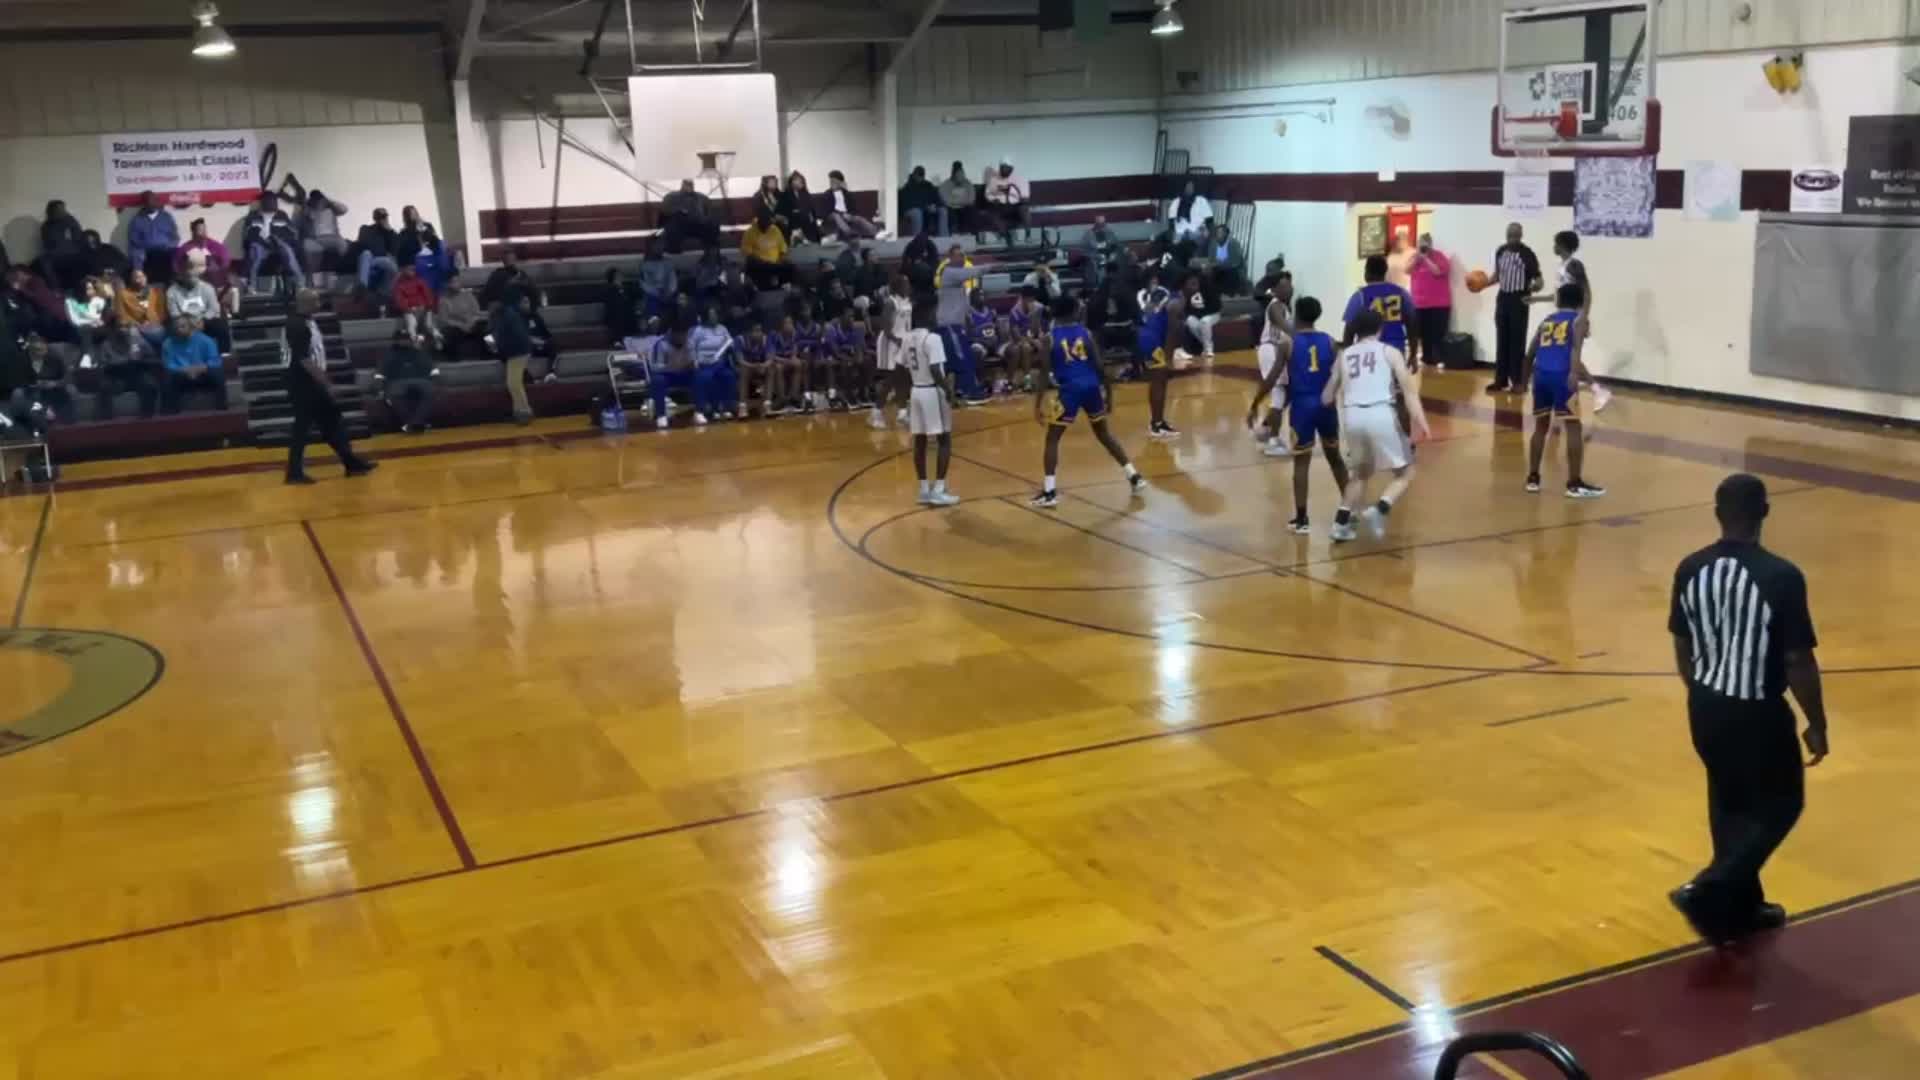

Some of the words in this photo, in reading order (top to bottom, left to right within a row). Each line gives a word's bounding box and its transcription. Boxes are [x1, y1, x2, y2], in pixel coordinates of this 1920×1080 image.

[172, 138, 245, 151] Hardwood
[112, 157, 198, 169] Tournament
[201, 154, 250, 166] Classic
[1540, 320, 1569, 347] 24
[1060, 336, 1089, 363] 14
[1307, 345, 1319, 373] 1
[1345, 351, 1378, 380] 34
